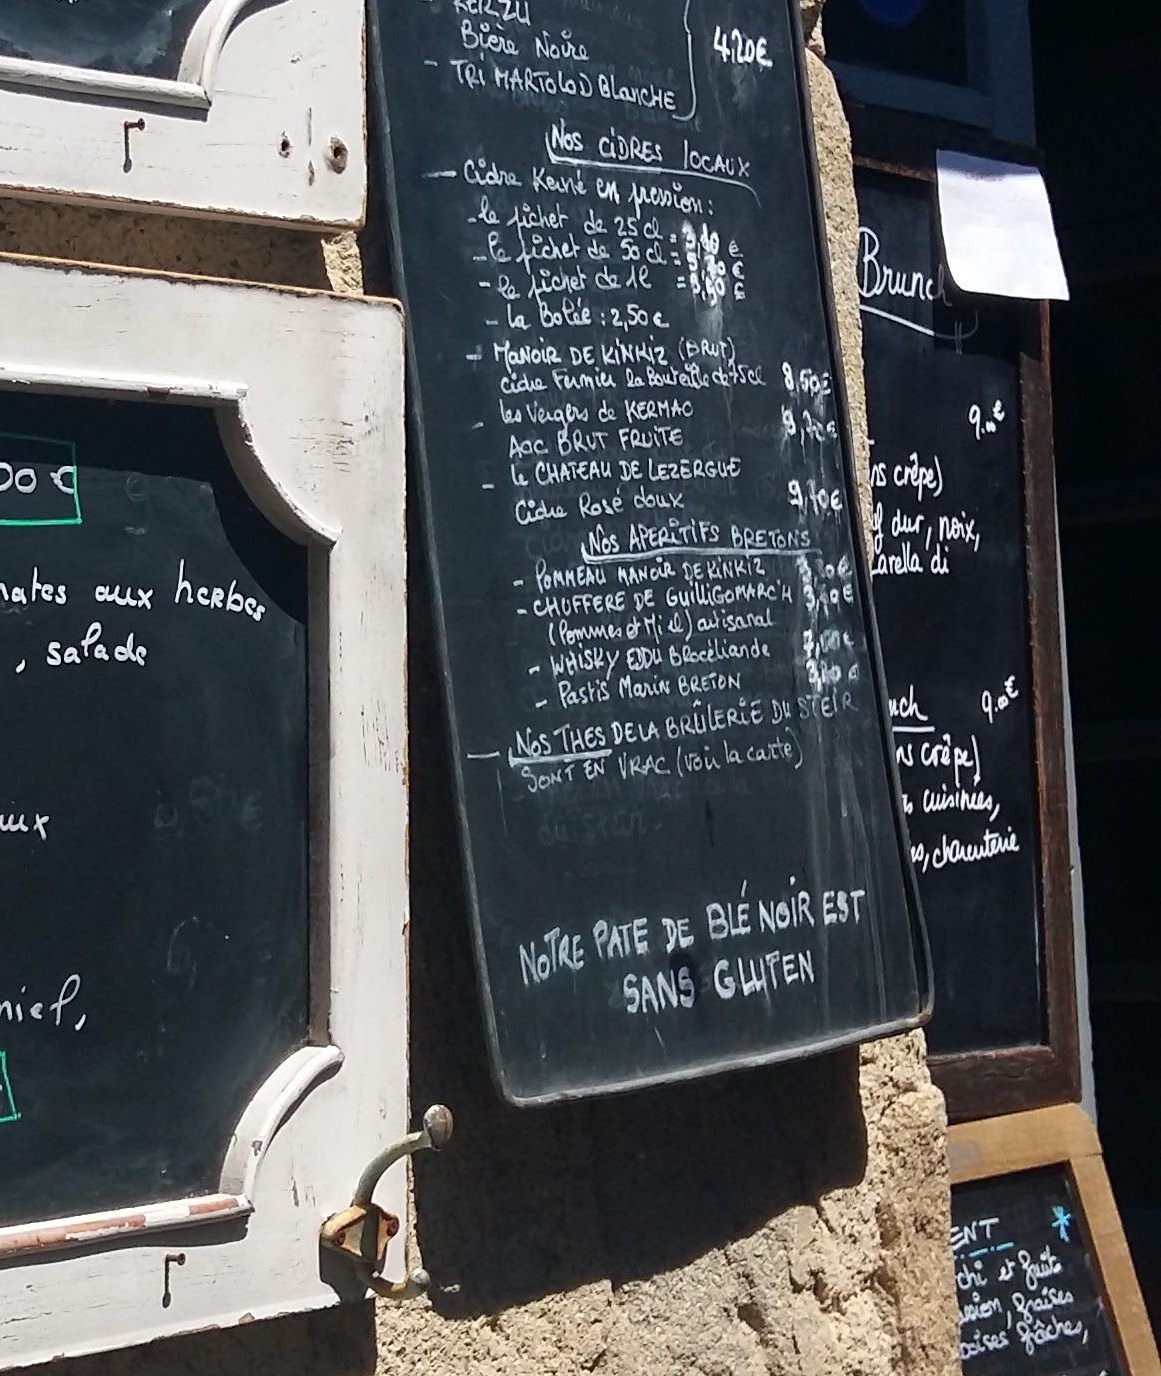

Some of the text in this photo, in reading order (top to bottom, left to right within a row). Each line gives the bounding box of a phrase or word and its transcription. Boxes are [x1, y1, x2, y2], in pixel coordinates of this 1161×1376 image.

[449, 52, 487, 90] TRI
[461, 156, 524, 188] Cidre
[613, 215, 640, 240] 25
[858, 226, 954, 307] Brunch
[569, 345, 596, 367] DE
[556, 425, 610, 458] BRUT
[534, 459, 613, 486] CHATEAU
[618, 460, 644, 482] DE
[578, 485, 625, 519] Rosé
[632, 484, 686, 509] doux
[683, 560, 705, 582] DE
[930, 542, 950, 575] di
[94, 582, 155, 611] aux
[175, 557, 268, 622] herbes
[633, 590, 656, 613] DE
[45, 621, 150, 667] salade
[677, 670, 743, 698] BRETON
[770, 698, 793, 725] DU
[584, 758, 607, 781] EN
[617, 754, 672, 780] VRAC
[518, 926, 587, 988] NOTRE
[592, 917, 651, 961] PATE
[660, 917, 696, 954] DE
[822, 888, 867, 926] EST
[622, 949, 817, 1015] SANS GLUTEN
[997, 1257, 1017, 1283] et
